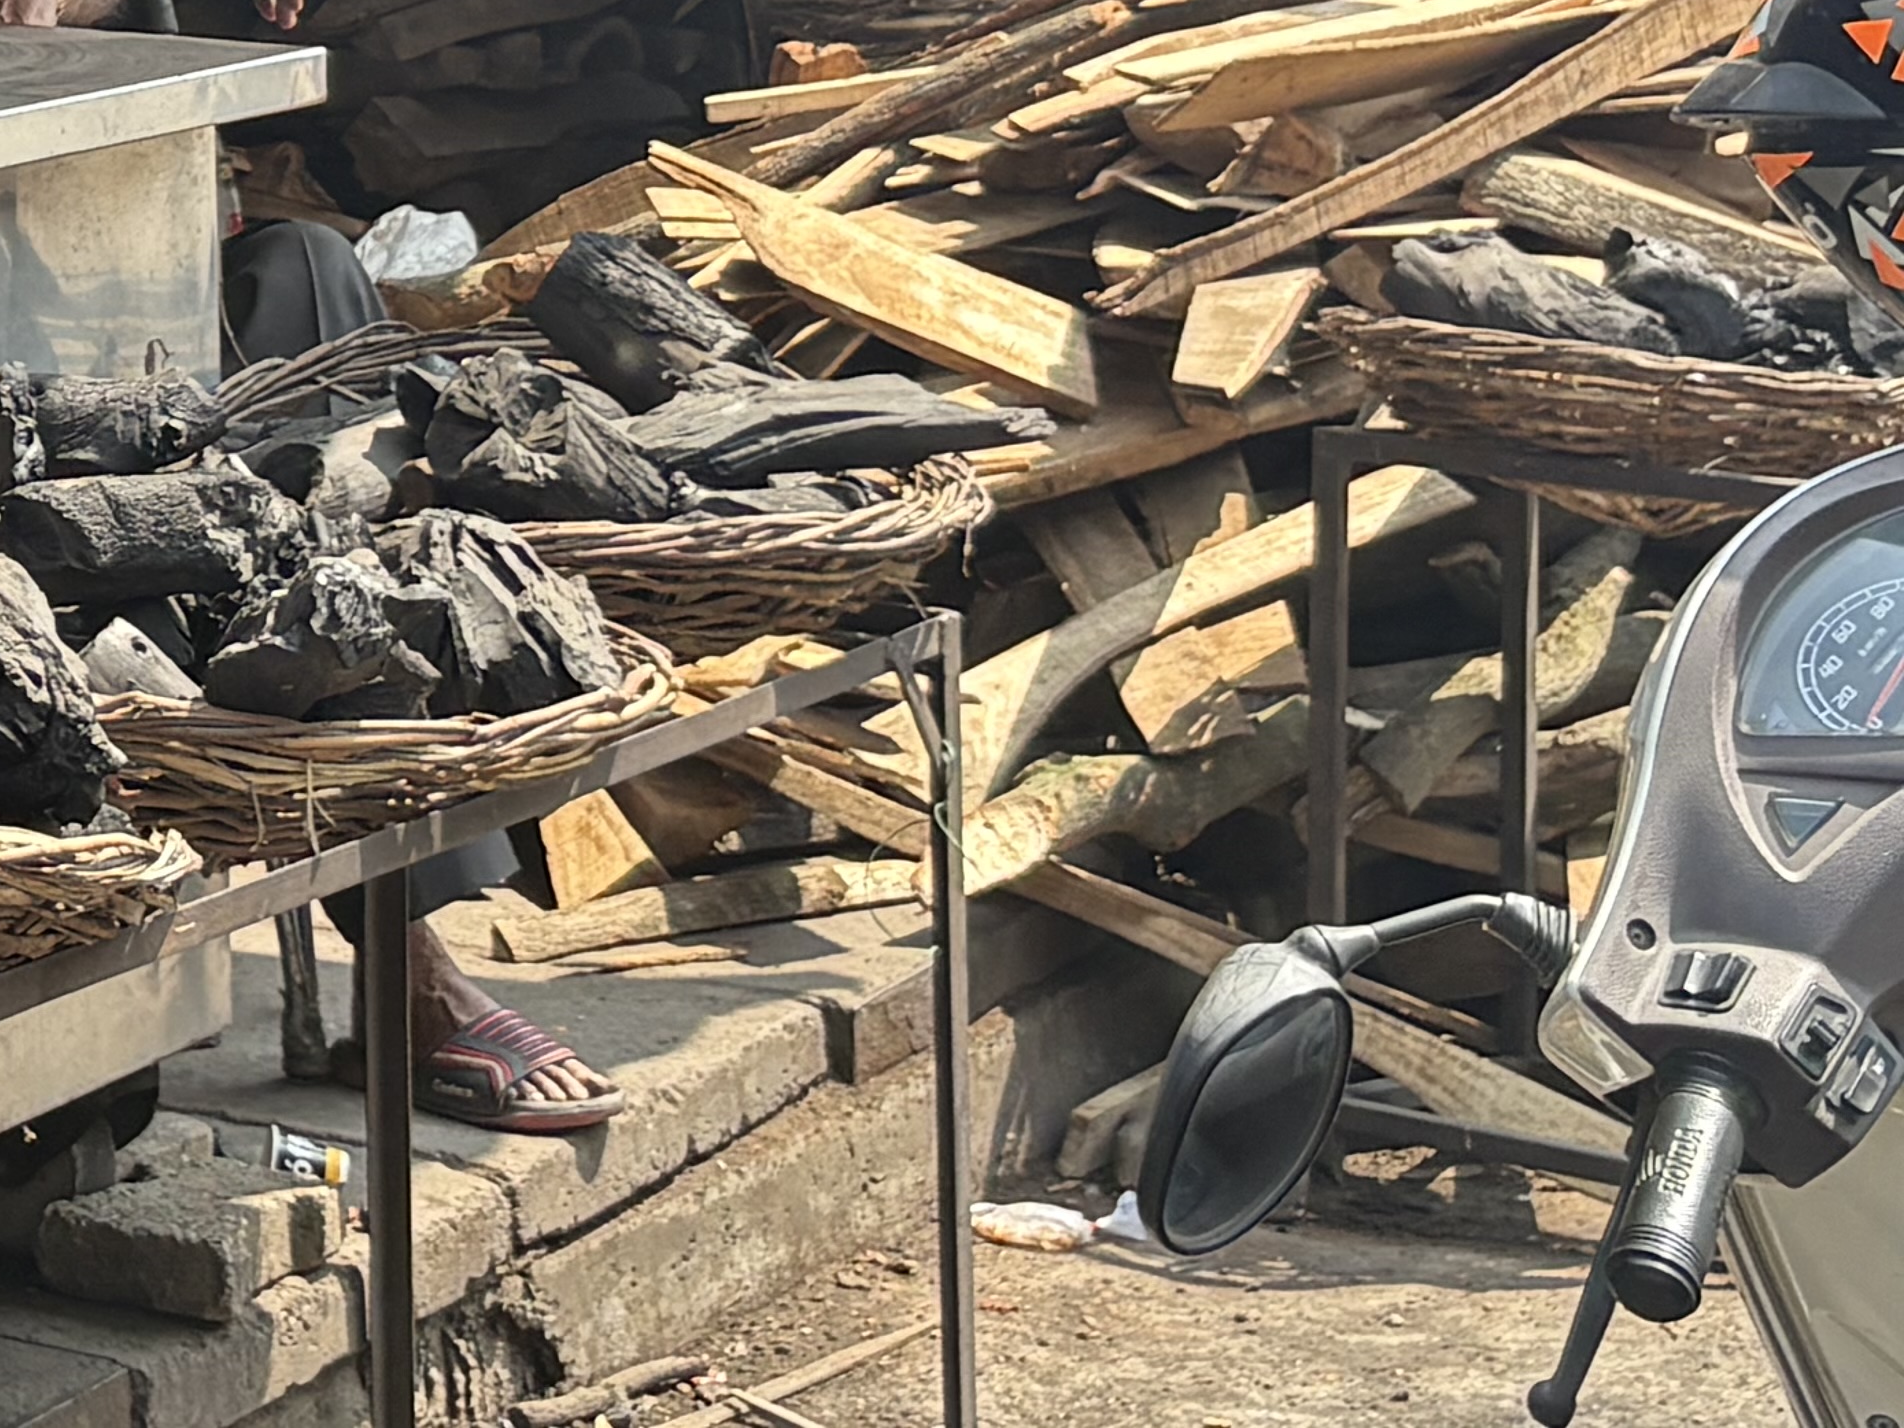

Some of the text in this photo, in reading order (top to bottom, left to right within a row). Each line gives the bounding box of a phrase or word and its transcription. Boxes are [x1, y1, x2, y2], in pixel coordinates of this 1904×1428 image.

[1831, 619, 1857, 644] 60
[1818, 654, 1844, 678] 40
[1830, 685, 1858, 711] 20
[1657, 1124, 1704, 1197] HONDA
